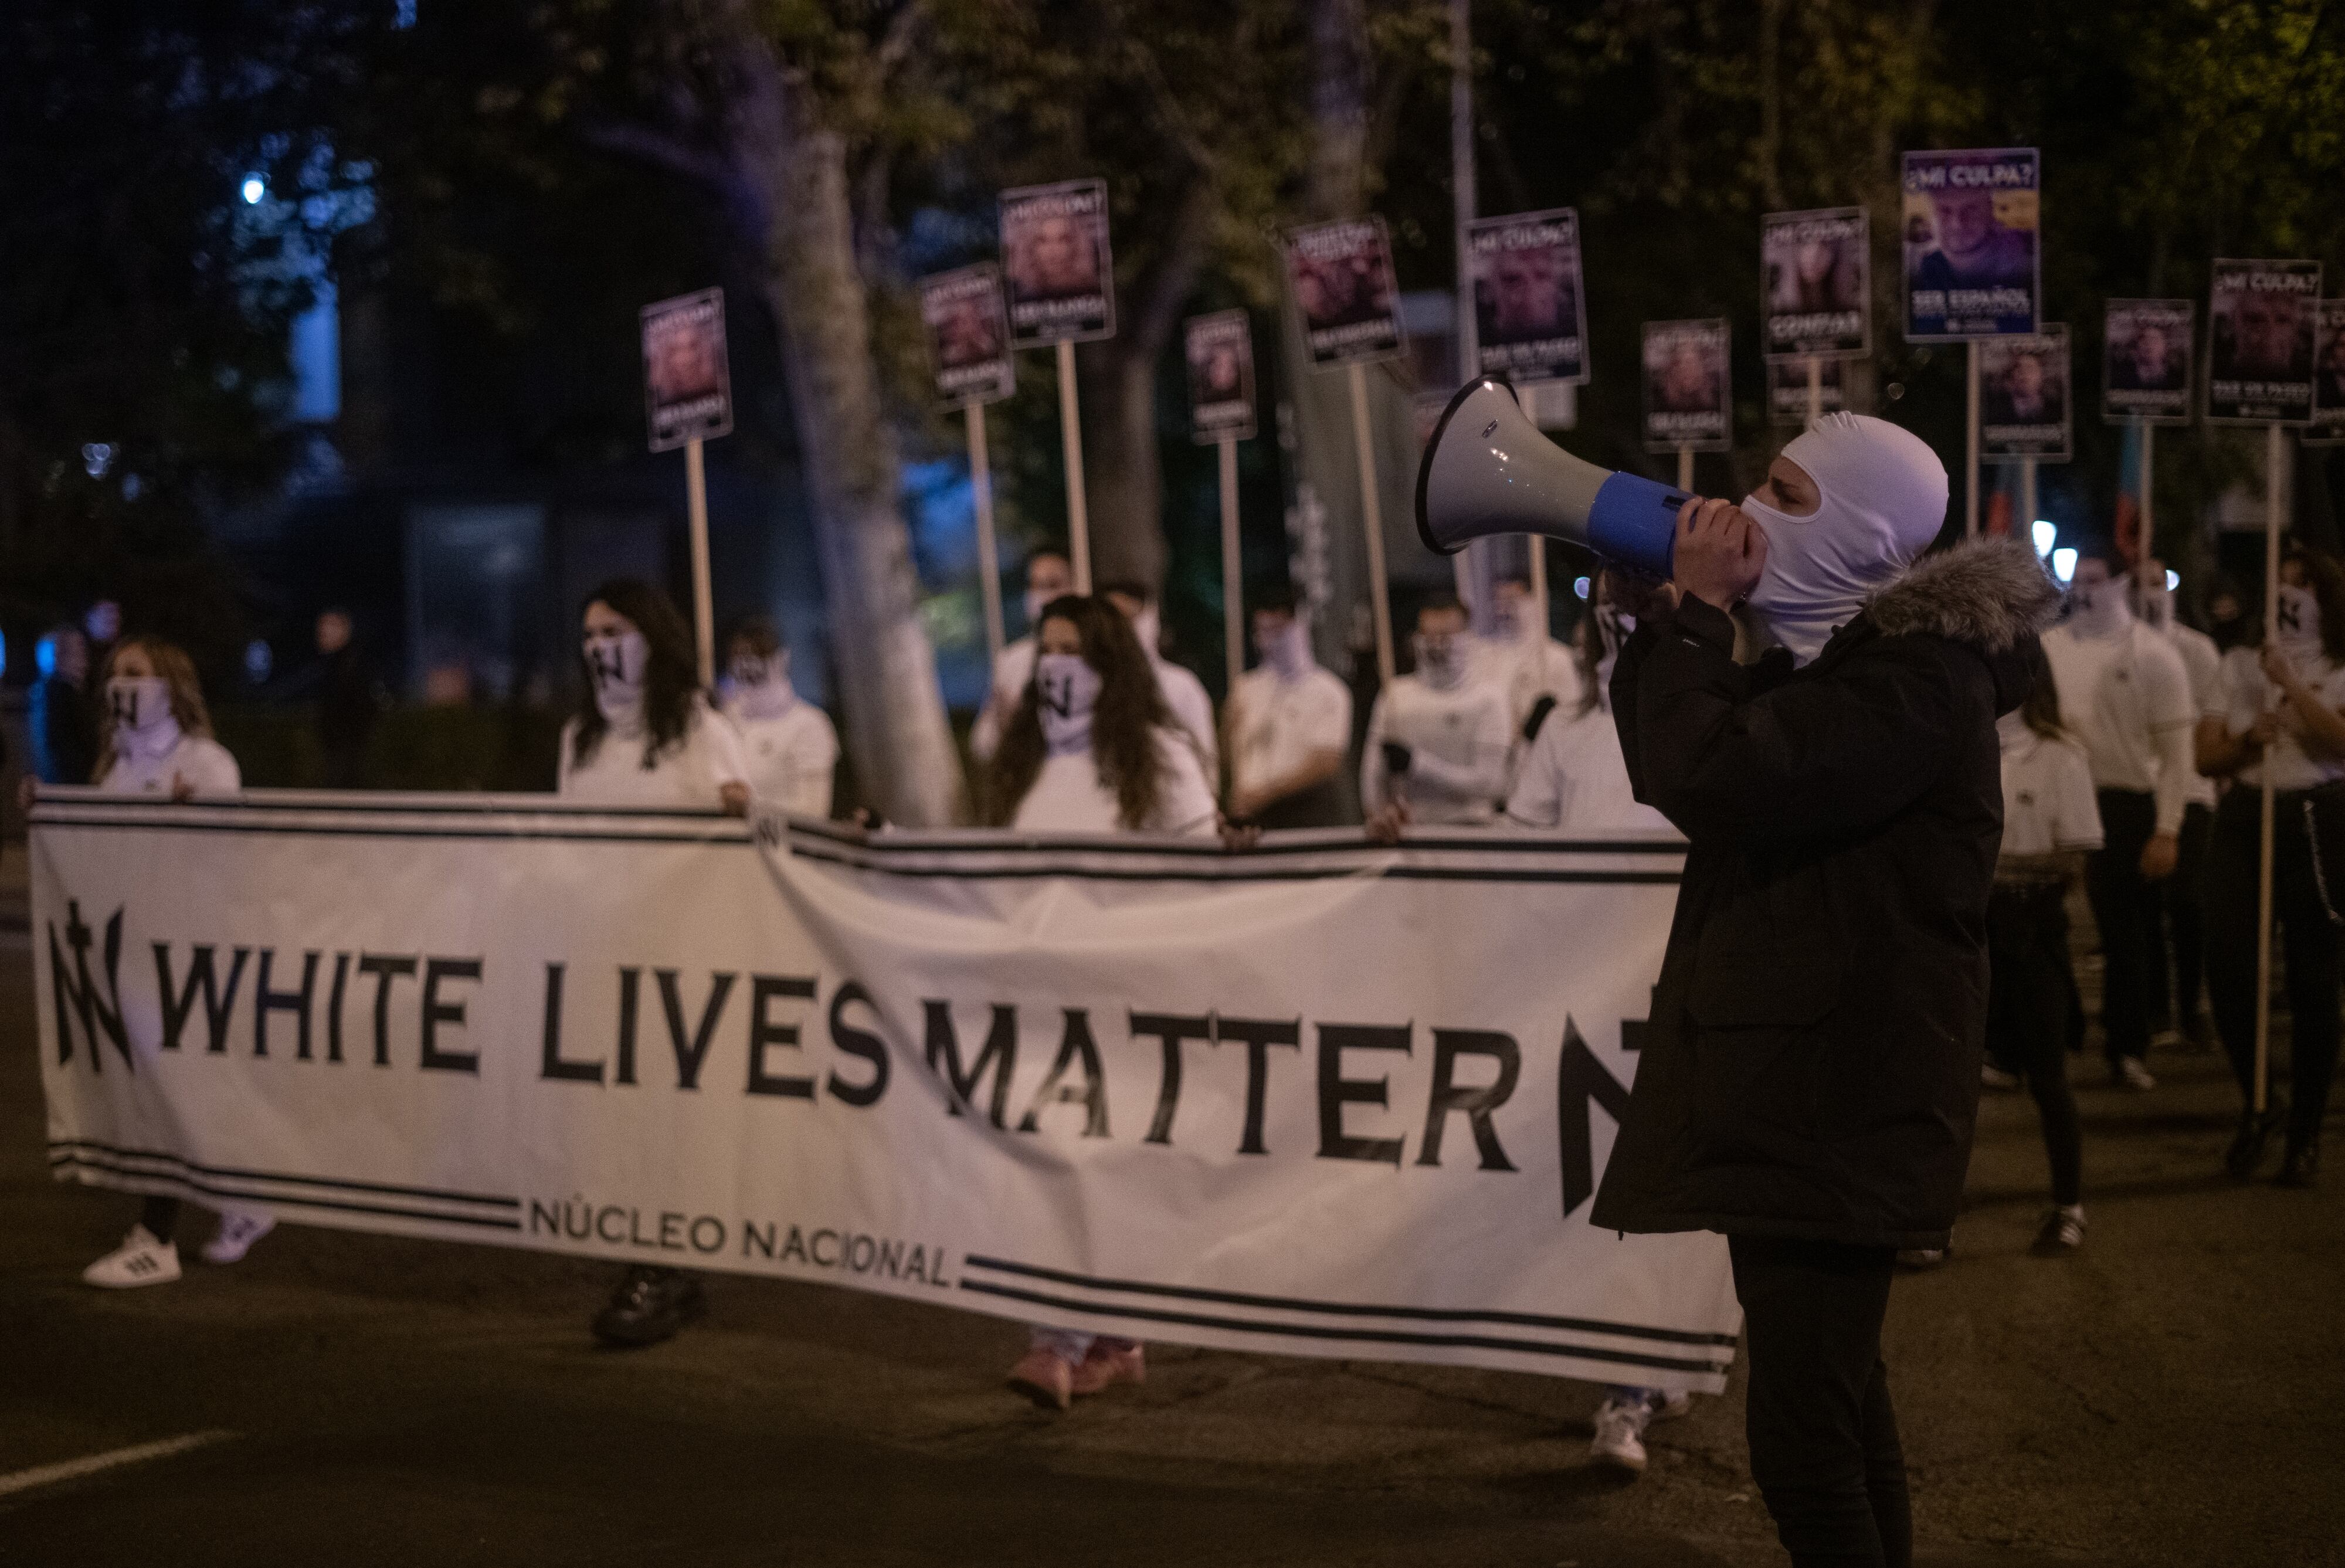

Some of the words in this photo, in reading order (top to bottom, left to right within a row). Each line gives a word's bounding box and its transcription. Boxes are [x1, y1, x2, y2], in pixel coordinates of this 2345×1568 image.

[1949, 162, 2032, 189] CULPA?
[151, 942, 483, 1074] WHITE
[541, 962, 892, 1107] LIVES
[922, 998, 1521, 1174] MATTER
[530, 1193, 726, 1254] NÚCLEO
[742, 1219, 951, 1289] NACIONAL
